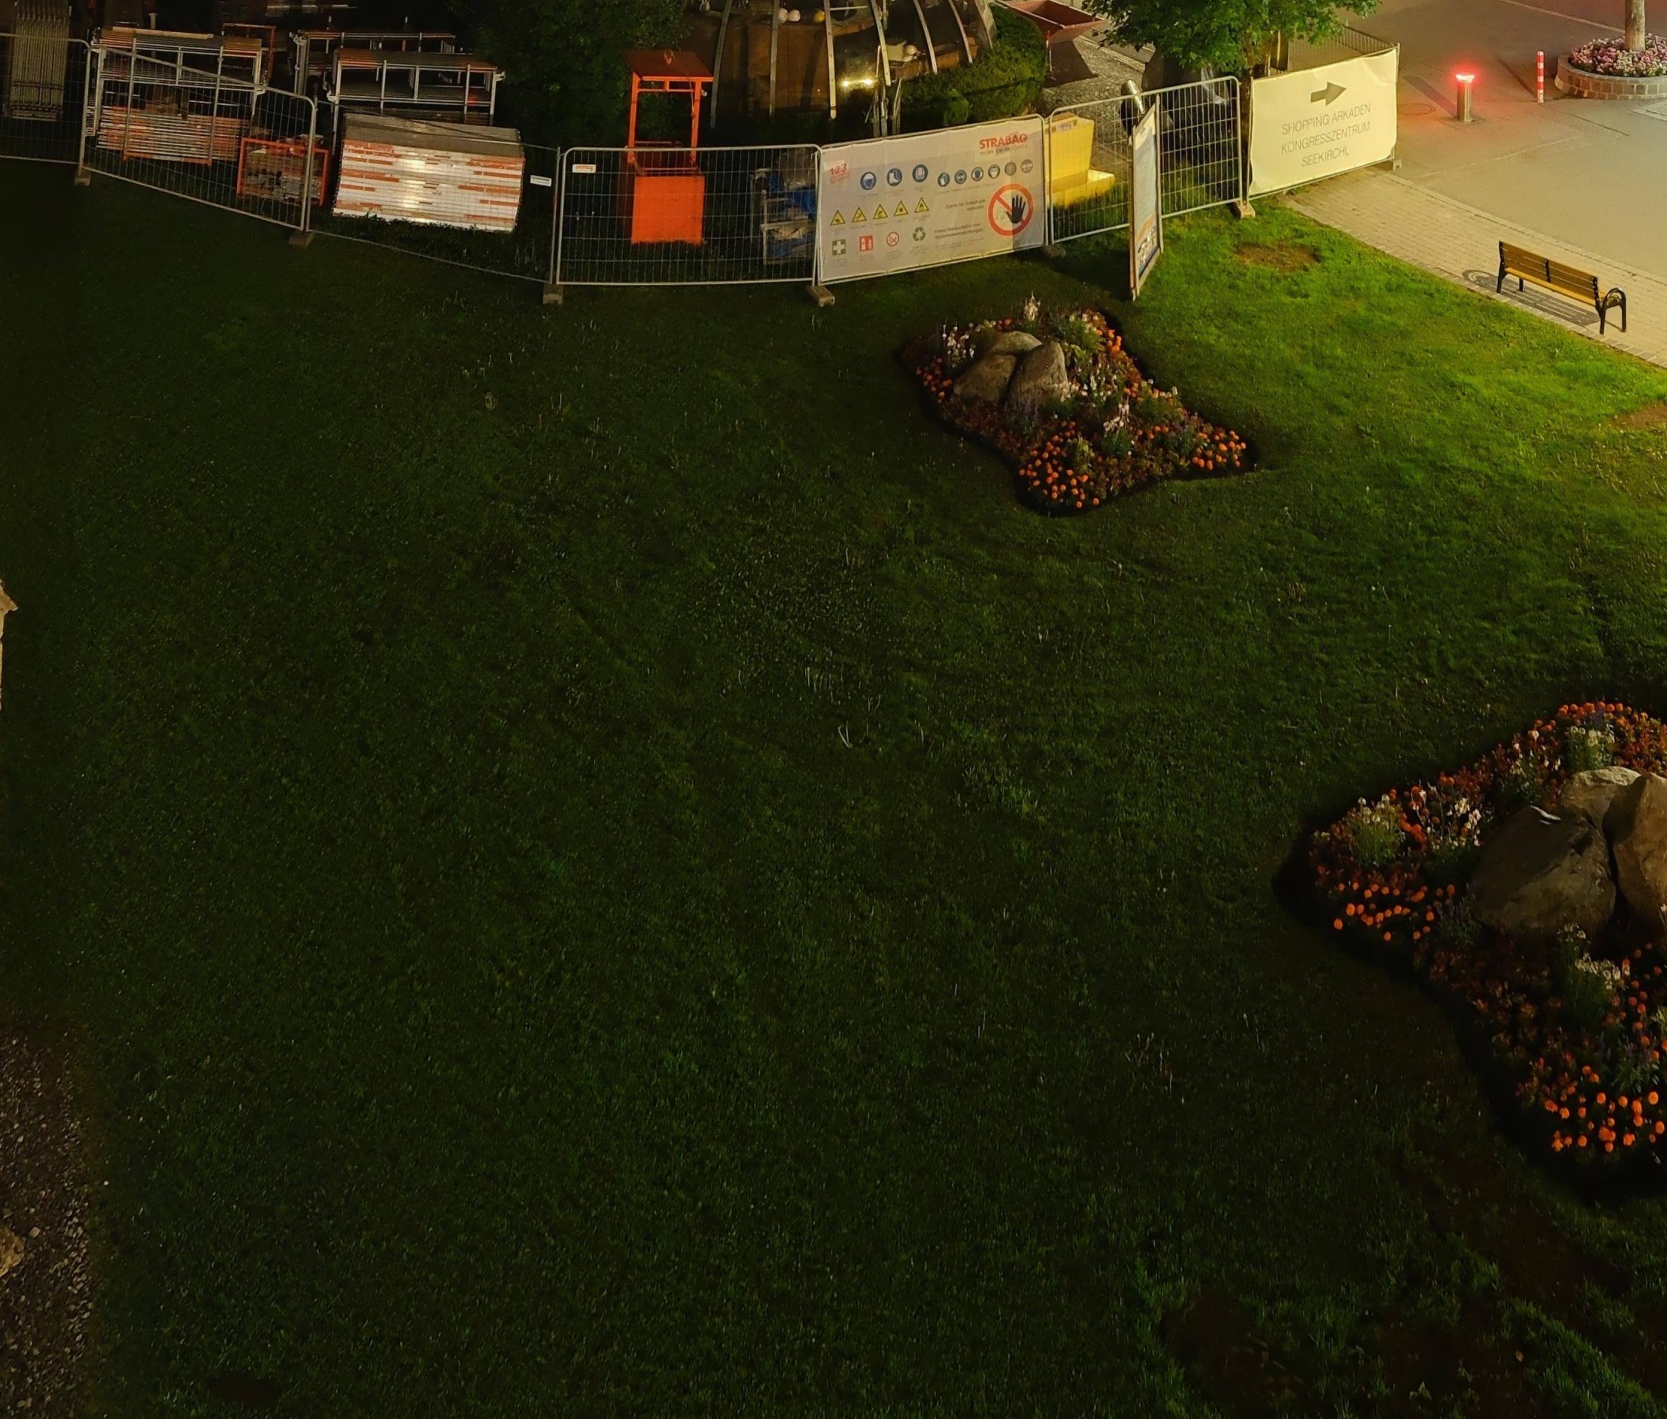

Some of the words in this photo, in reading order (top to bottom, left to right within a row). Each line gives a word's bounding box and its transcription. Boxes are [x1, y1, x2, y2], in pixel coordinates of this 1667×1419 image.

[1281, 113, 1330, 135] SHOPPING
[1331, 102, 1371, 123] ARKADEN
[979, 132, 1028, 150] STRABAG
[1281, 120, 1371, 155] KONGRESSZENTRUM
[1301, 145, 1350, 168] SEEKIRCHL
